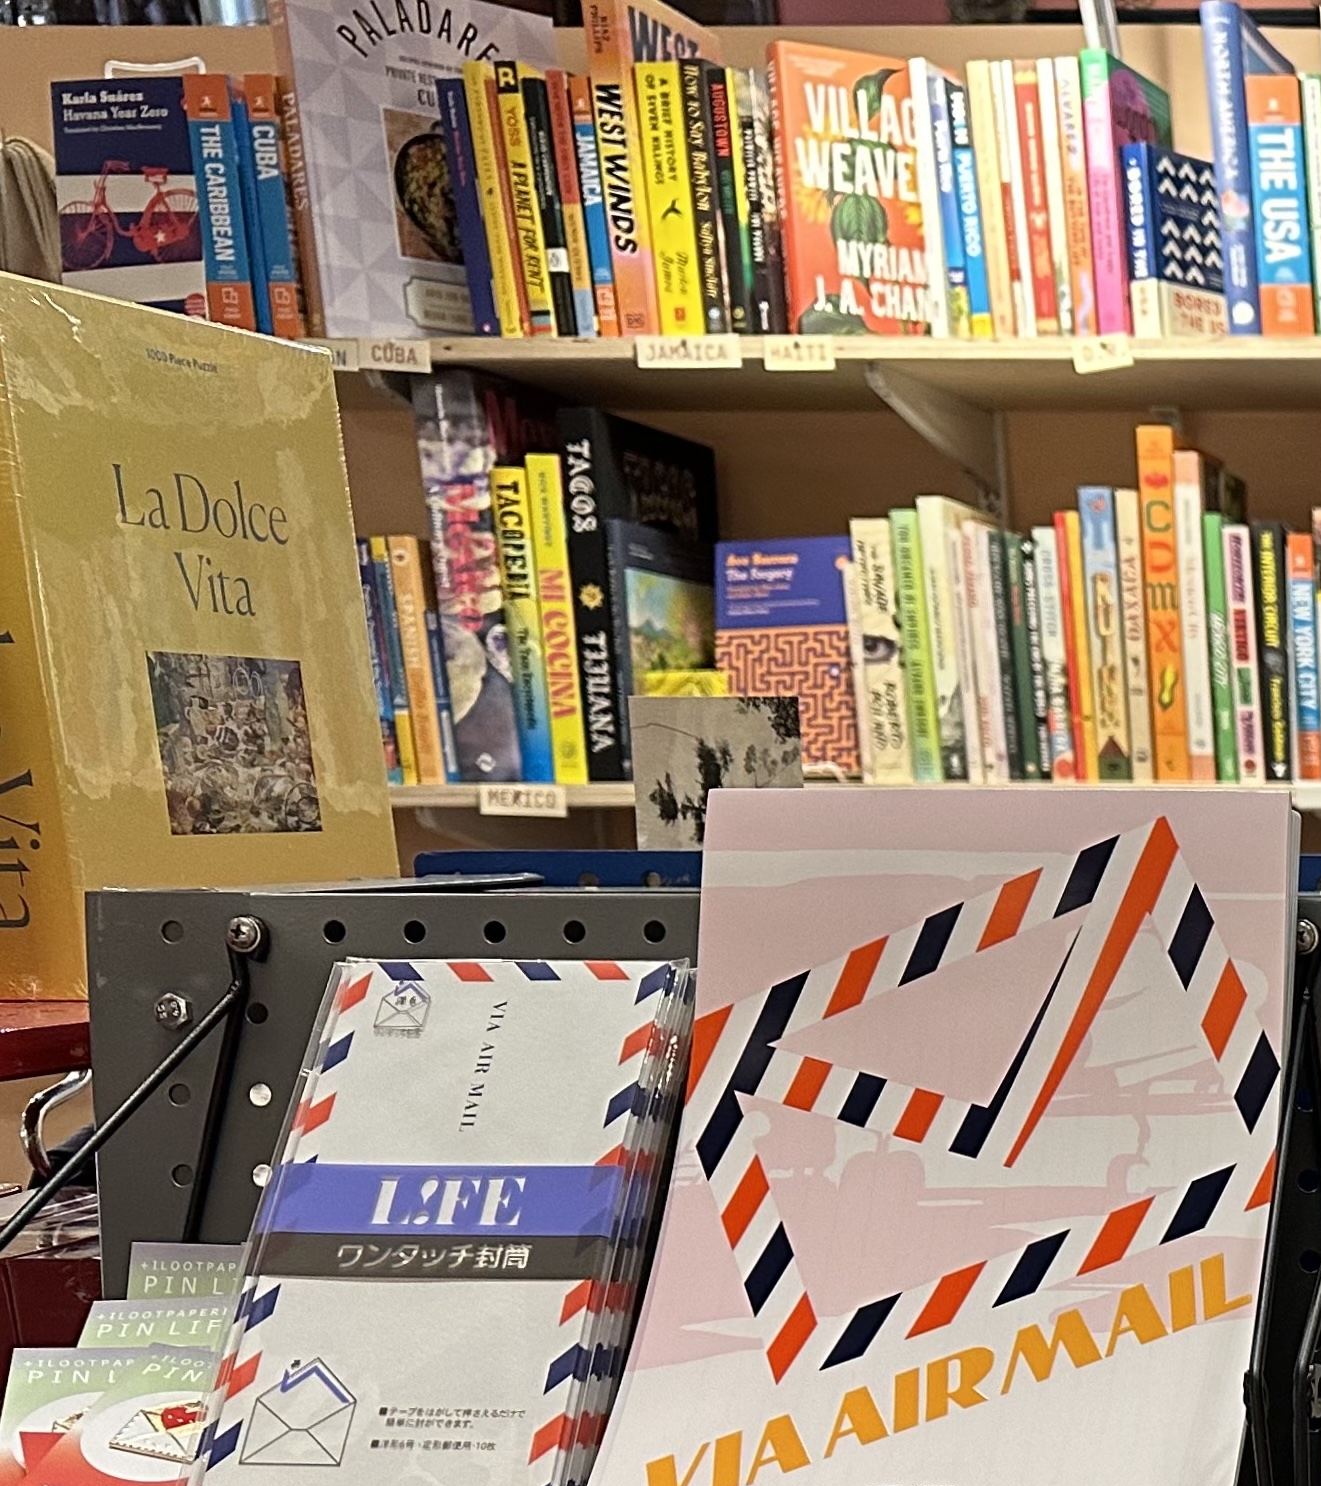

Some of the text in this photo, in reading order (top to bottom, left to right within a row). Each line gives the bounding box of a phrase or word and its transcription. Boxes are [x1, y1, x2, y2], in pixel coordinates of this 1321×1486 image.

[200, 124, 235, 262] THE CARIBBEAN
[252, 125, 280, 180] CUBA
[595, 83, 638, 255] WEST WINDS
[1256, 126, 1299, 265] THE USA
[372, 345, 419, 365] CUBA
[111, 463, 290, 546] La Dolce
[496, 479, 530, 602] TACOPEDIA
[174, 550, 256, 618] Vita
[538, 568, 578, 719] MI COCINA
[567, 438, 616, 752] TACOS TIJUANA
[487, 789, 556, 809] MEXICO
[460, 1000, 508, 1132] VIA AIR MAIL
[337, 1243, 534, 1270] ワンタッチ封筒
